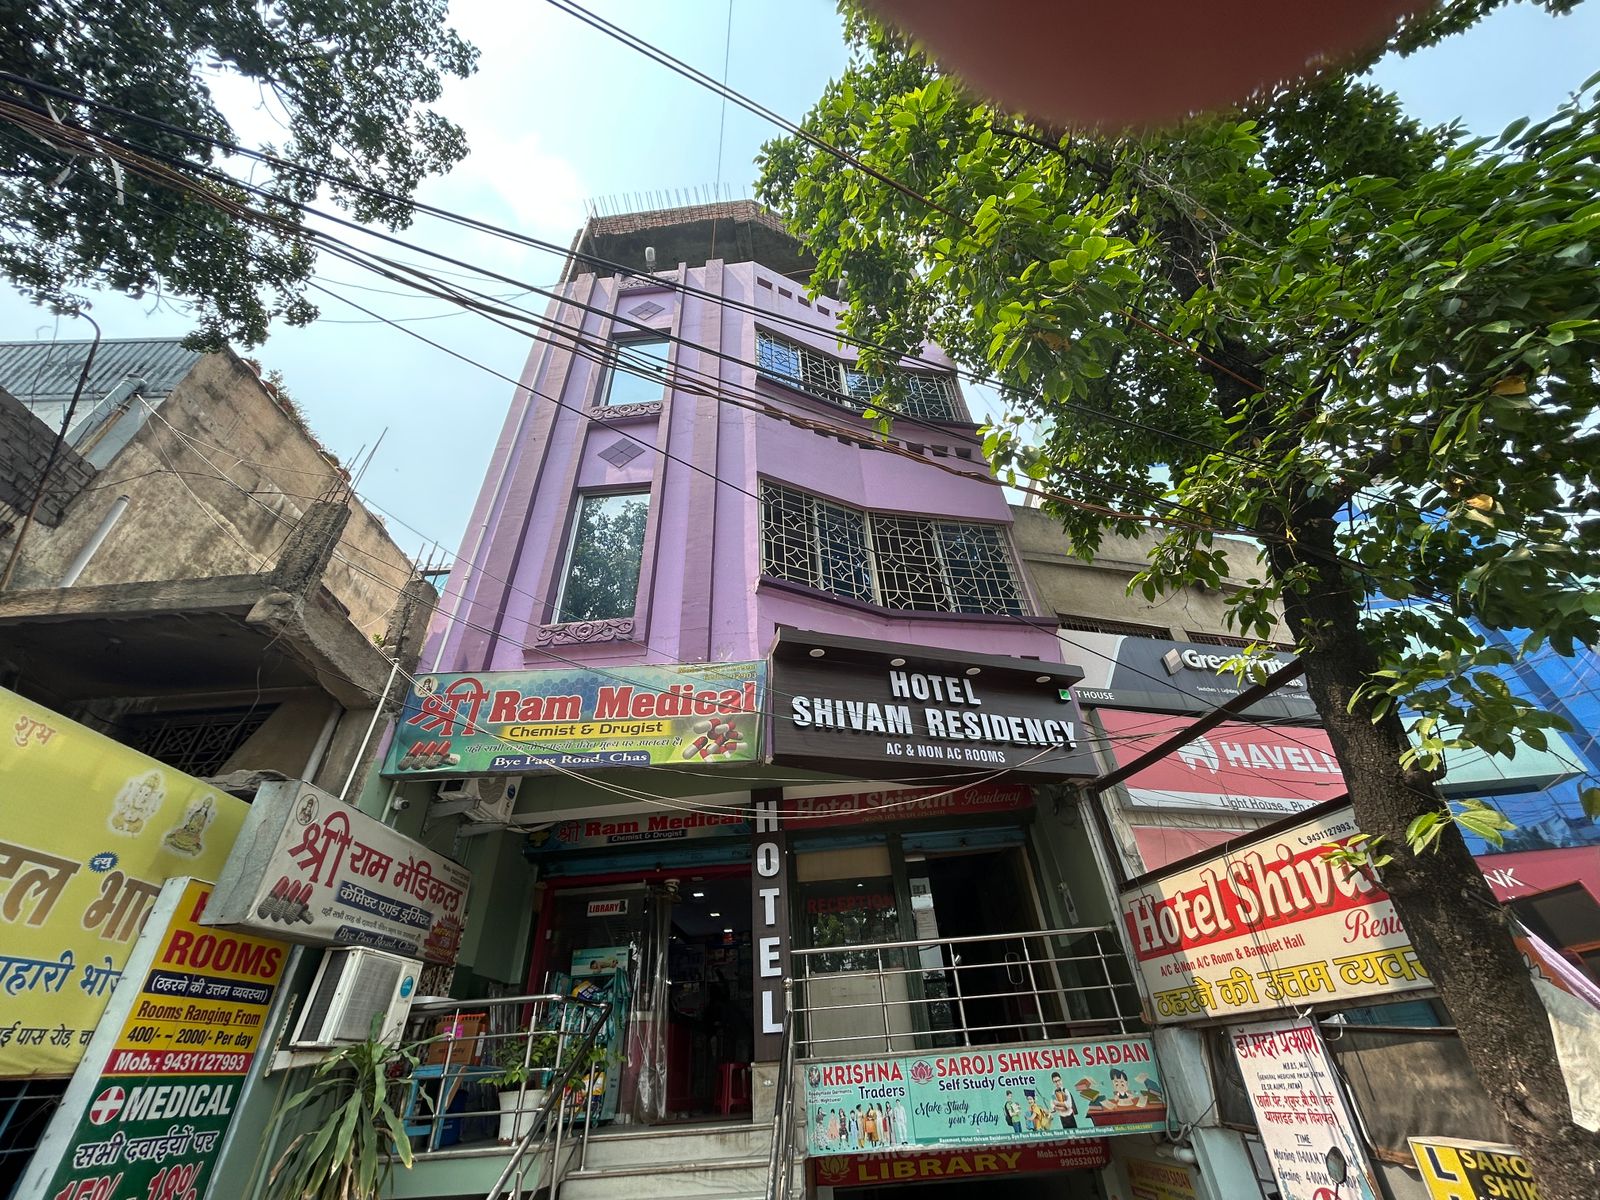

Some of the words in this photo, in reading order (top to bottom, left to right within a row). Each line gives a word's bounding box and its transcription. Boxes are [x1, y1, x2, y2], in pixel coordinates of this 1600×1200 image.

[488, 689, 582, 724] Ram
[594, 680, 758, 720] Medical
[890, 671, 981, 705] HOTEL
[1083, 692, 1114, 700] HOUSE
[406, 677, 490, 737] श्री
[14, 715, 56, 748] शुभ
[510, 724, 576, 737] Chemist
[581, 724, 594, 735] &
[600, 722, 663, 736] Drugist
[792, 696, 913, 734] SHIVAM
[925, 708, 1078, 748] RESIDENCY
[494, 758, 520, 768] Bye
[526, 756, 556, 765] Pass
[610, 753, 648, 762] Chas
[886, 742, 902, 756] AC
[906, 745, 914, 757] &
[918, 745, 943, 759] NON
[947, 748, 962, 761] AC
[965, 750, 1006, 763] ROOMS
[797, 795, 860, 818] Hotel
[865, 790, 955, 811] Shivam
[960, 788, 1020, 806] Residency
[1220, 797, 1250, 810] Light
[584, 818, 638, 837] Ram
[648, 810, 742, 831] Medical
[612, 833, 642, 842] Chemist
[644, 832, 651, 840] &
[652, 830, 682, 840] Drugist
[288, 810, 352, 888] श्री
[349, 840, 394, 883] राम
[393, 856, 463, 912] मेडिकल
[83, 871, 161, 943] भा
[588, 902, 620, 913] LIBRARY
[756, 800, 782, 1034] HOTEL
[1130, 868, 1235, 952] Hotel
[162, 930, 282, 978] ROOMS
[1160, 964, 1172, 977] A/C
[1174, 962, 1180, 974] &
[1180, 961, 1196, 972] Non
[1197, 956, 1210, 969] A/C
[1211, 950, 1235, 965] Room
[1235, 948, 1243, 960] &
[1244, 938, 1284, 958] Banquet
[1284, 933, 1306, 950] Hall
[80, 956, 123, 996] भो
[190, 978, 206, 994] की
[206, 984, 232, 996] उत्तम
[1153, 977, 1216, 1017] ठहरने
[1216, 966, 1259, 1007] की
[1257, 960, 1336, 1000] उत्तम
[136, 1000, 183, 1020] Rooms
[184, 1004, 233, 1026] Ranging
[233, 1010, 261, 1026] From
[16, 1028, 49, 1046] पास
[79, 1030, 96, 1046] चा
[127, 1026, 162, 1044] 400/-
[176, 1028, 212, 1046] 2000/-
[214, 1031, 234, 1045] Per
[234, 1032, 254, 1049] day
[1276, 1026, 1320, 1058] प्रकाश
[113, 1052, 160, 1071] Mob.:
[162, 1053, 246, 1071] 9431127993
[823, 1061, 904, 1087] KRISHNA
[935, 1054, 994, 1078] SAROJ
[998, 1047, 1081, 1073] SHIKSHA
[1085, 1042, 1150, 1066] SADAN
[858, 1084, 905, 1100] Traders
[938, 1079, 961, 1091] Self
[963, 1077, 996, 1092] Study
[998, 1074, 1036, 1087] Centre
[120, 1084, 234, 1122] MEDICAL
[915, 1102, 942, 1118] Make
[944, 1100, 970, 1115] Study
[948, 1115, 966, 1128] your
[968, 1111, 999, 1128] Hobby
[74, 1131, 124, 1168] सभी
[193, 1130, 220, 1152] पर
[1294, 1134, 1312, 1144] TIME
[858, 1152, 1022, 1181] LIBRARY
[1459, 1150, 1532, 1178] SARO
[1482, 1174, 1543, 1200] SHIK
